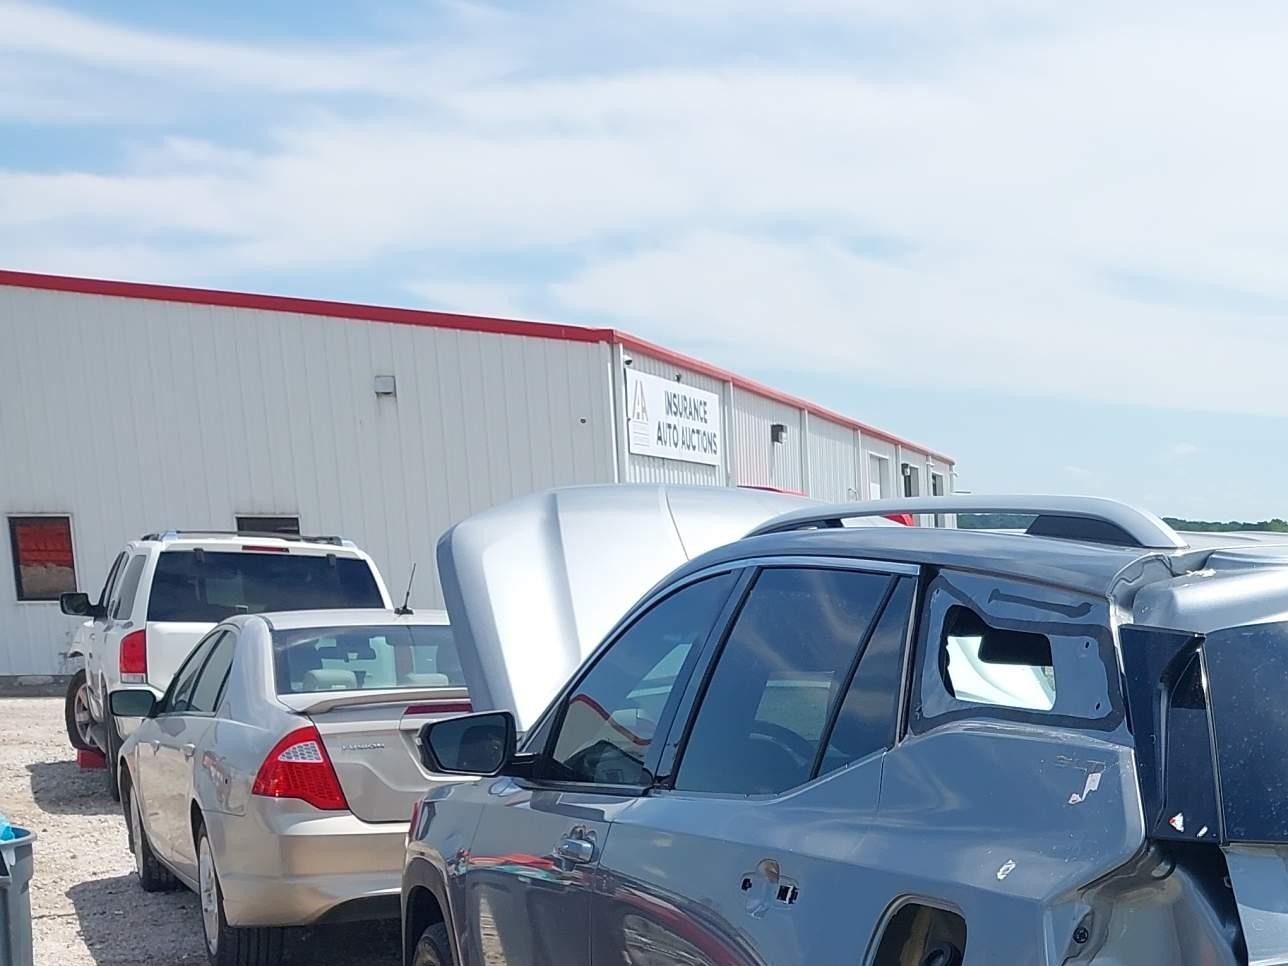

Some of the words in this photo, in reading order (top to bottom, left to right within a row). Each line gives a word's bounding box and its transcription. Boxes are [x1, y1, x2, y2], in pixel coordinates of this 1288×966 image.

[664, 390, 708, 424] INSURANCE
[656, 420, 679, 448] AUTO
[681, 426, 718, 455] AUCTIONS
